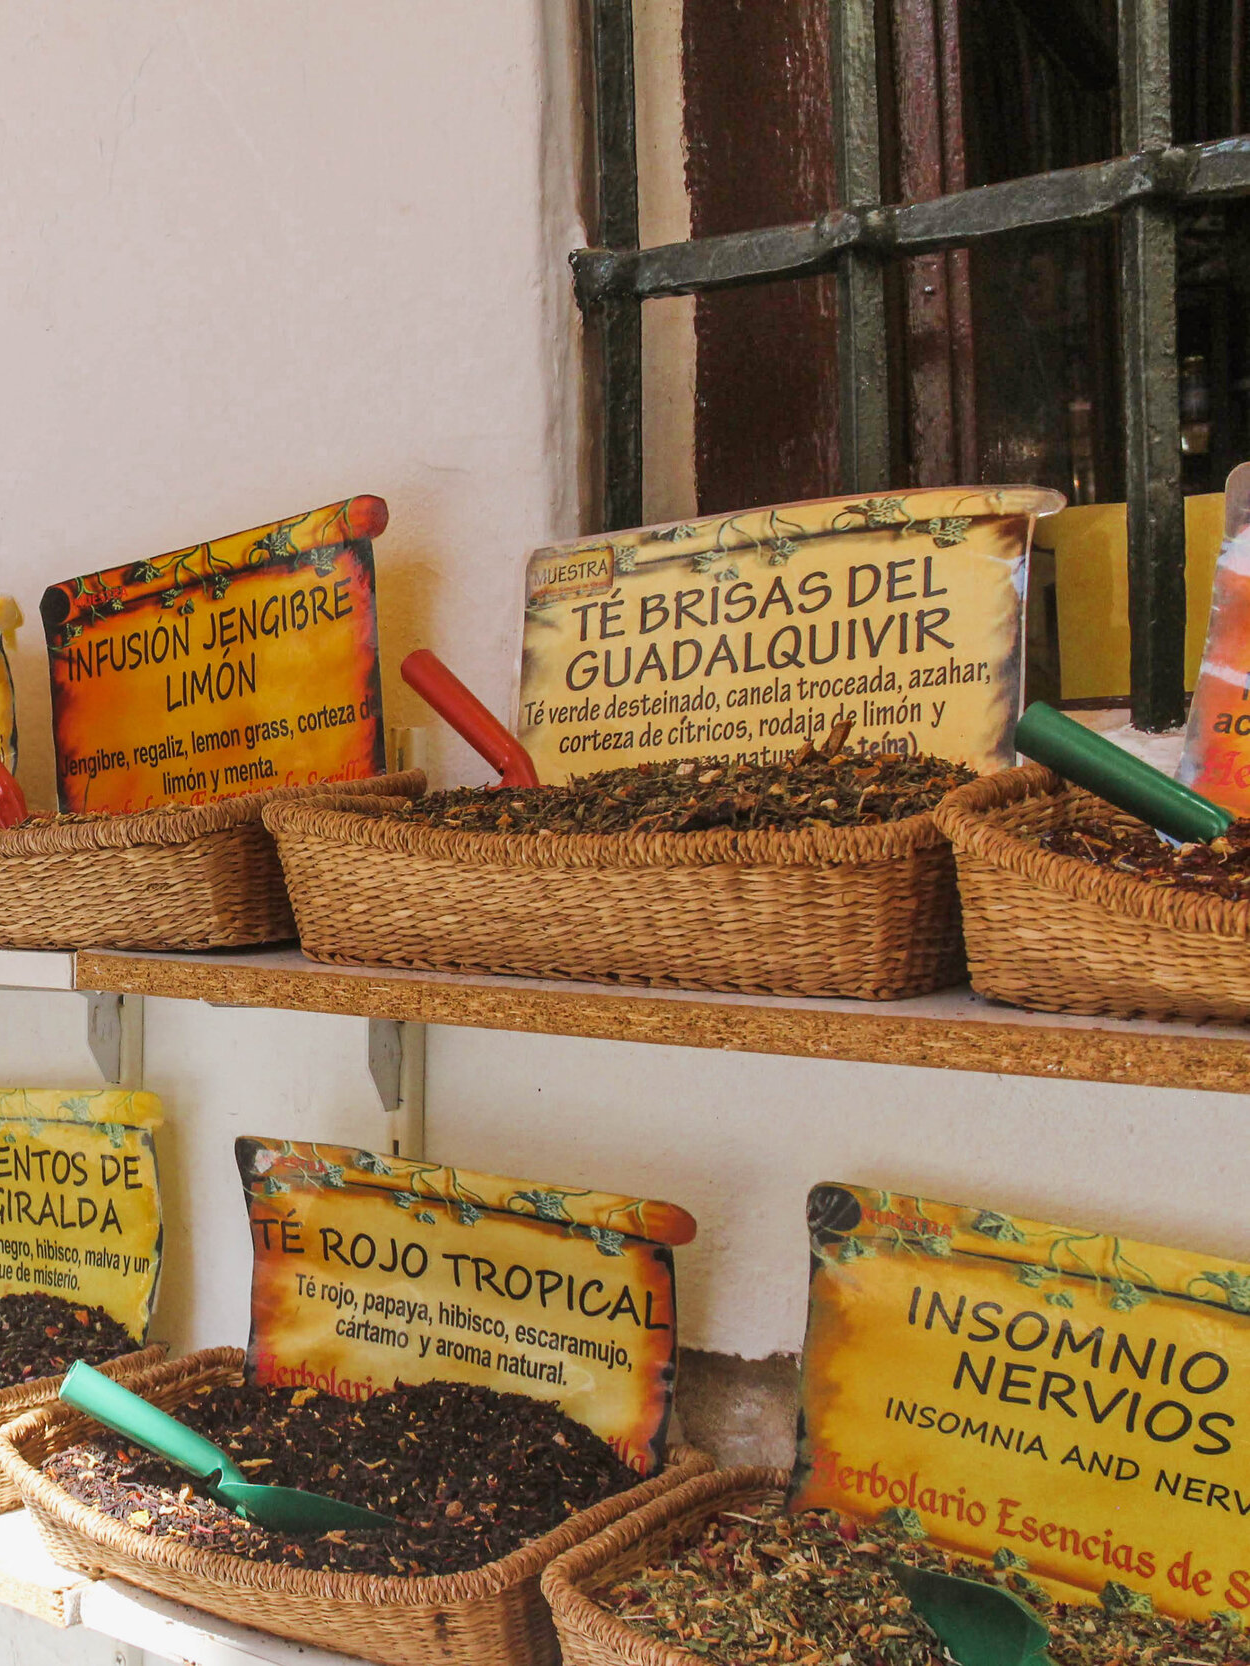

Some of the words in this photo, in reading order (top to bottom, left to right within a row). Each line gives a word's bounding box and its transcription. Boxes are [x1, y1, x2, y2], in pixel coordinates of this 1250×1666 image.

[534, 559, 608, 585] MUESTRA
[571, 588, 625, 642] TÉ
[639, 571, 834, 633] BRISAS
[848, 555, 947, 608] DEL
[68, 616, 190, 682] INFUSIÓN
[203, 576, 353, 650] JENGIBRE
[566, 606, 955, 692] GUADALQUIVIR
[166, 647, 257, 713] LIMÓN
[524, 701, 545, 727] Té
[548, 694, 602, 726] verde
[605, 690, 721, 725] desteinado,
[727, 678, 791, 712] canela
[797, 666, 904, 703] troceada,
[908, 657, 991, 689] azahar,
[60, 746, 130, 779] Jengibre,
[133, 734, 188, 767] regaliz,
[191, 726, 241, 756] lemon
[245, 715, 295, 750] grass,
[297, 702, 355, 734] corteza
[360, 694, 380, 718] de
[558, 723, 635, 755] corteza
[638, 718, 663, 748] de
[667, 713, 753, 746] cítricos,
[758, 707, 826, 743] rodaja
[830, 702, 858, 729] de
[862, 697, 922, 727] limón
[931, 699, 947, 728] y
[736, 746, 802, 768] natur
[162, 768, 206, 795] limón
[211, 766, 220, 792] y
[224, 755, 279, 783] menta.
[100, 1154, 143, 1190] DE
[36, 1238, 81, 1267] hibisco,
[85, 1248, 119, 1269] malva
[123, 1256, 131, 1277] y
[134, 1256, 150, 1274] un
[861, 1208, 952, 1238] MUESTRA
[16, 1264, 30, 1283] de
[34, 1267, 80, 1291] misterio.
[253, 1210, 304, 1255] TÉ
[320, 1227, 428, 1279] ROJO
[442, 1252, 670, 1331] TROPICAL
[295, 1273, 316, 1298] Té
[320, 1279, 359, 1310] rojo,
[363, 1290, 433, 1326] papaya,
[438, 1302, 510, 1344] hibisco,
[514, 1325, 633, 1372] escaramujo,
[335, 1316, 410, 1350] cártamo
[418, 1335, 431, 1358] y
[436, 1337, 492, 1370] aroma
[496, 1353, 568, 1387] natural.
[908, 1286, 1230, 1396] INSOMNIO
[885, 1397, 1049, 1461] INSOMNIA
[1061, 1445, 1140, 1482] AND
[953, 1352, 1235, 1456] NERVIOS
[810, 1448, 988, 1528] Herbolario
[997, 1498, 1155, 1579] Esencias
[1167, 1551, 1212, 1597] de
